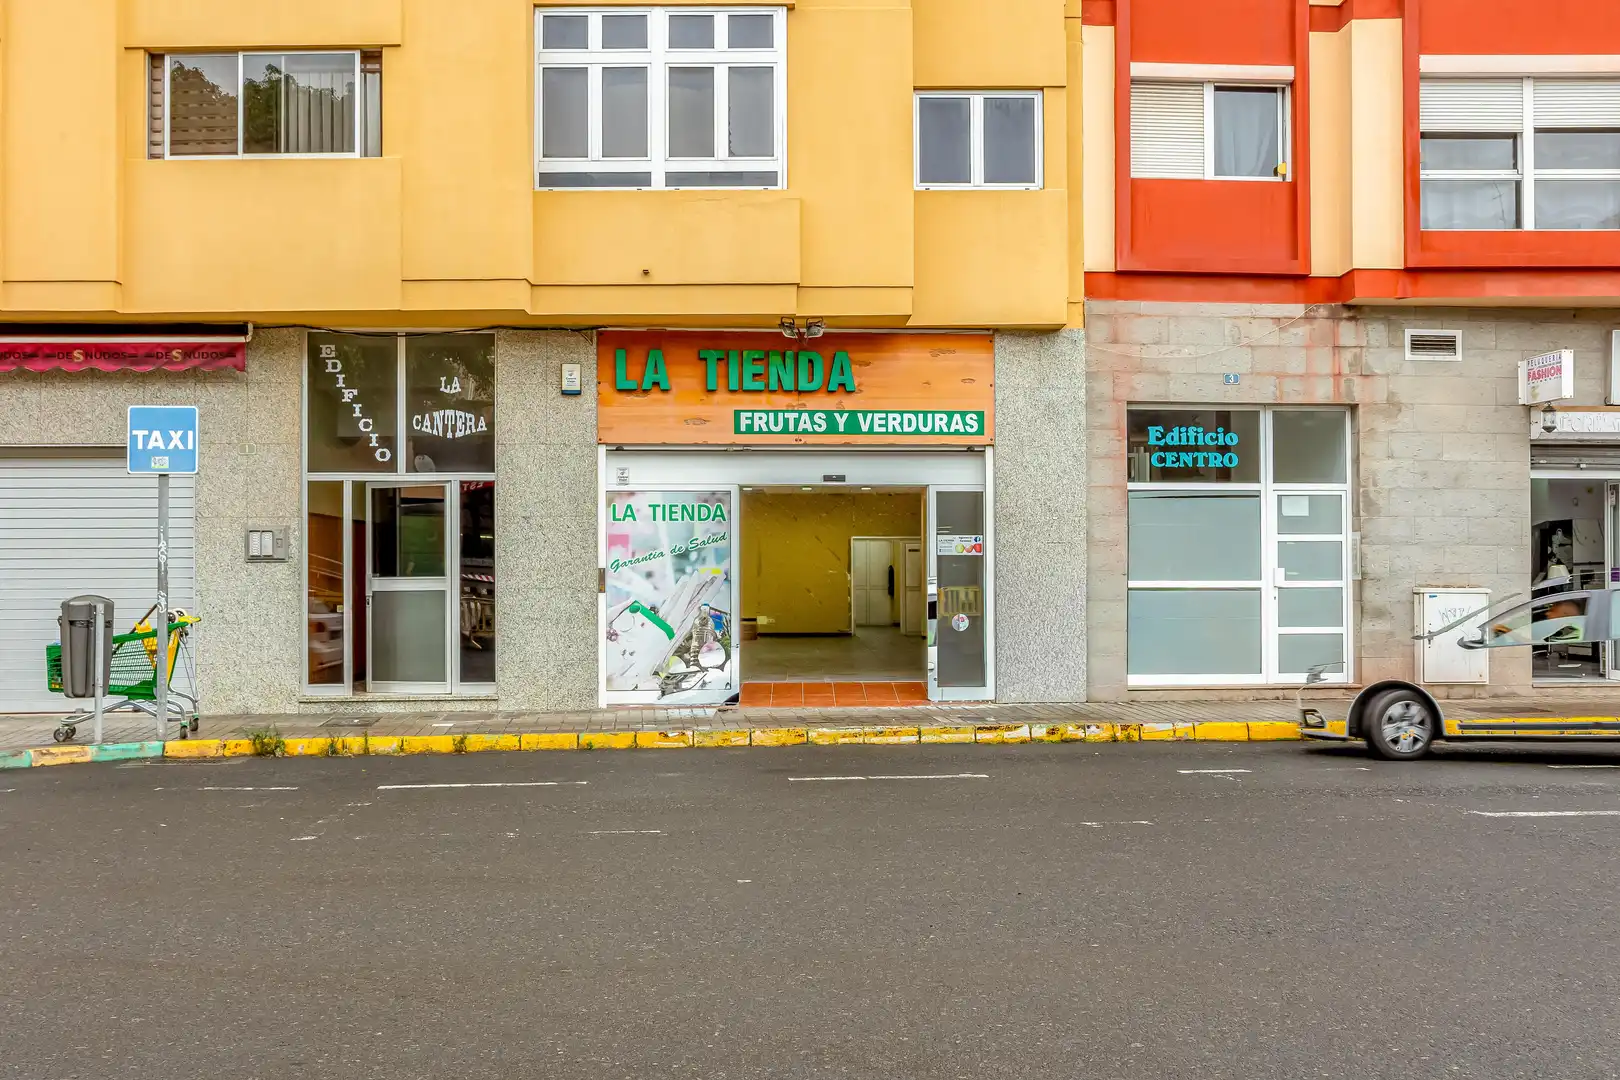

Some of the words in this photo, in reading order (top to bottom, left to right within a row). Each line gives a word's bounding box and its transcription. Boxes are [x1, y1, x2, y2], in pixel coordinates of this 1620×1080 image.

[614, 348, 671, 392] LA
[699, 348, 857, 393] TIENDA
[1527, 364, 1562, 382] FASHION
[440, 376, 461, 394] LA
[320, 345, 391, 462] EDIFICIO
[412, 409, 487, 439] CANTERA
[739, 411, 827, 433] FRUTAS
[833, 412, 850, 432] Y
[857, 412, 979, 433] VERDURAS
[132, 429, 194, 450] TAXI
[1147, 425, 1239, 446] Edificio
[1150, 451, 1239, 468] CENTRO
[611, 503, 637, 522] LA
[648, 503, 727, 522] TIENDA
[669, 543, 685, 555] de
[688, 531, 728, 551] Salud
